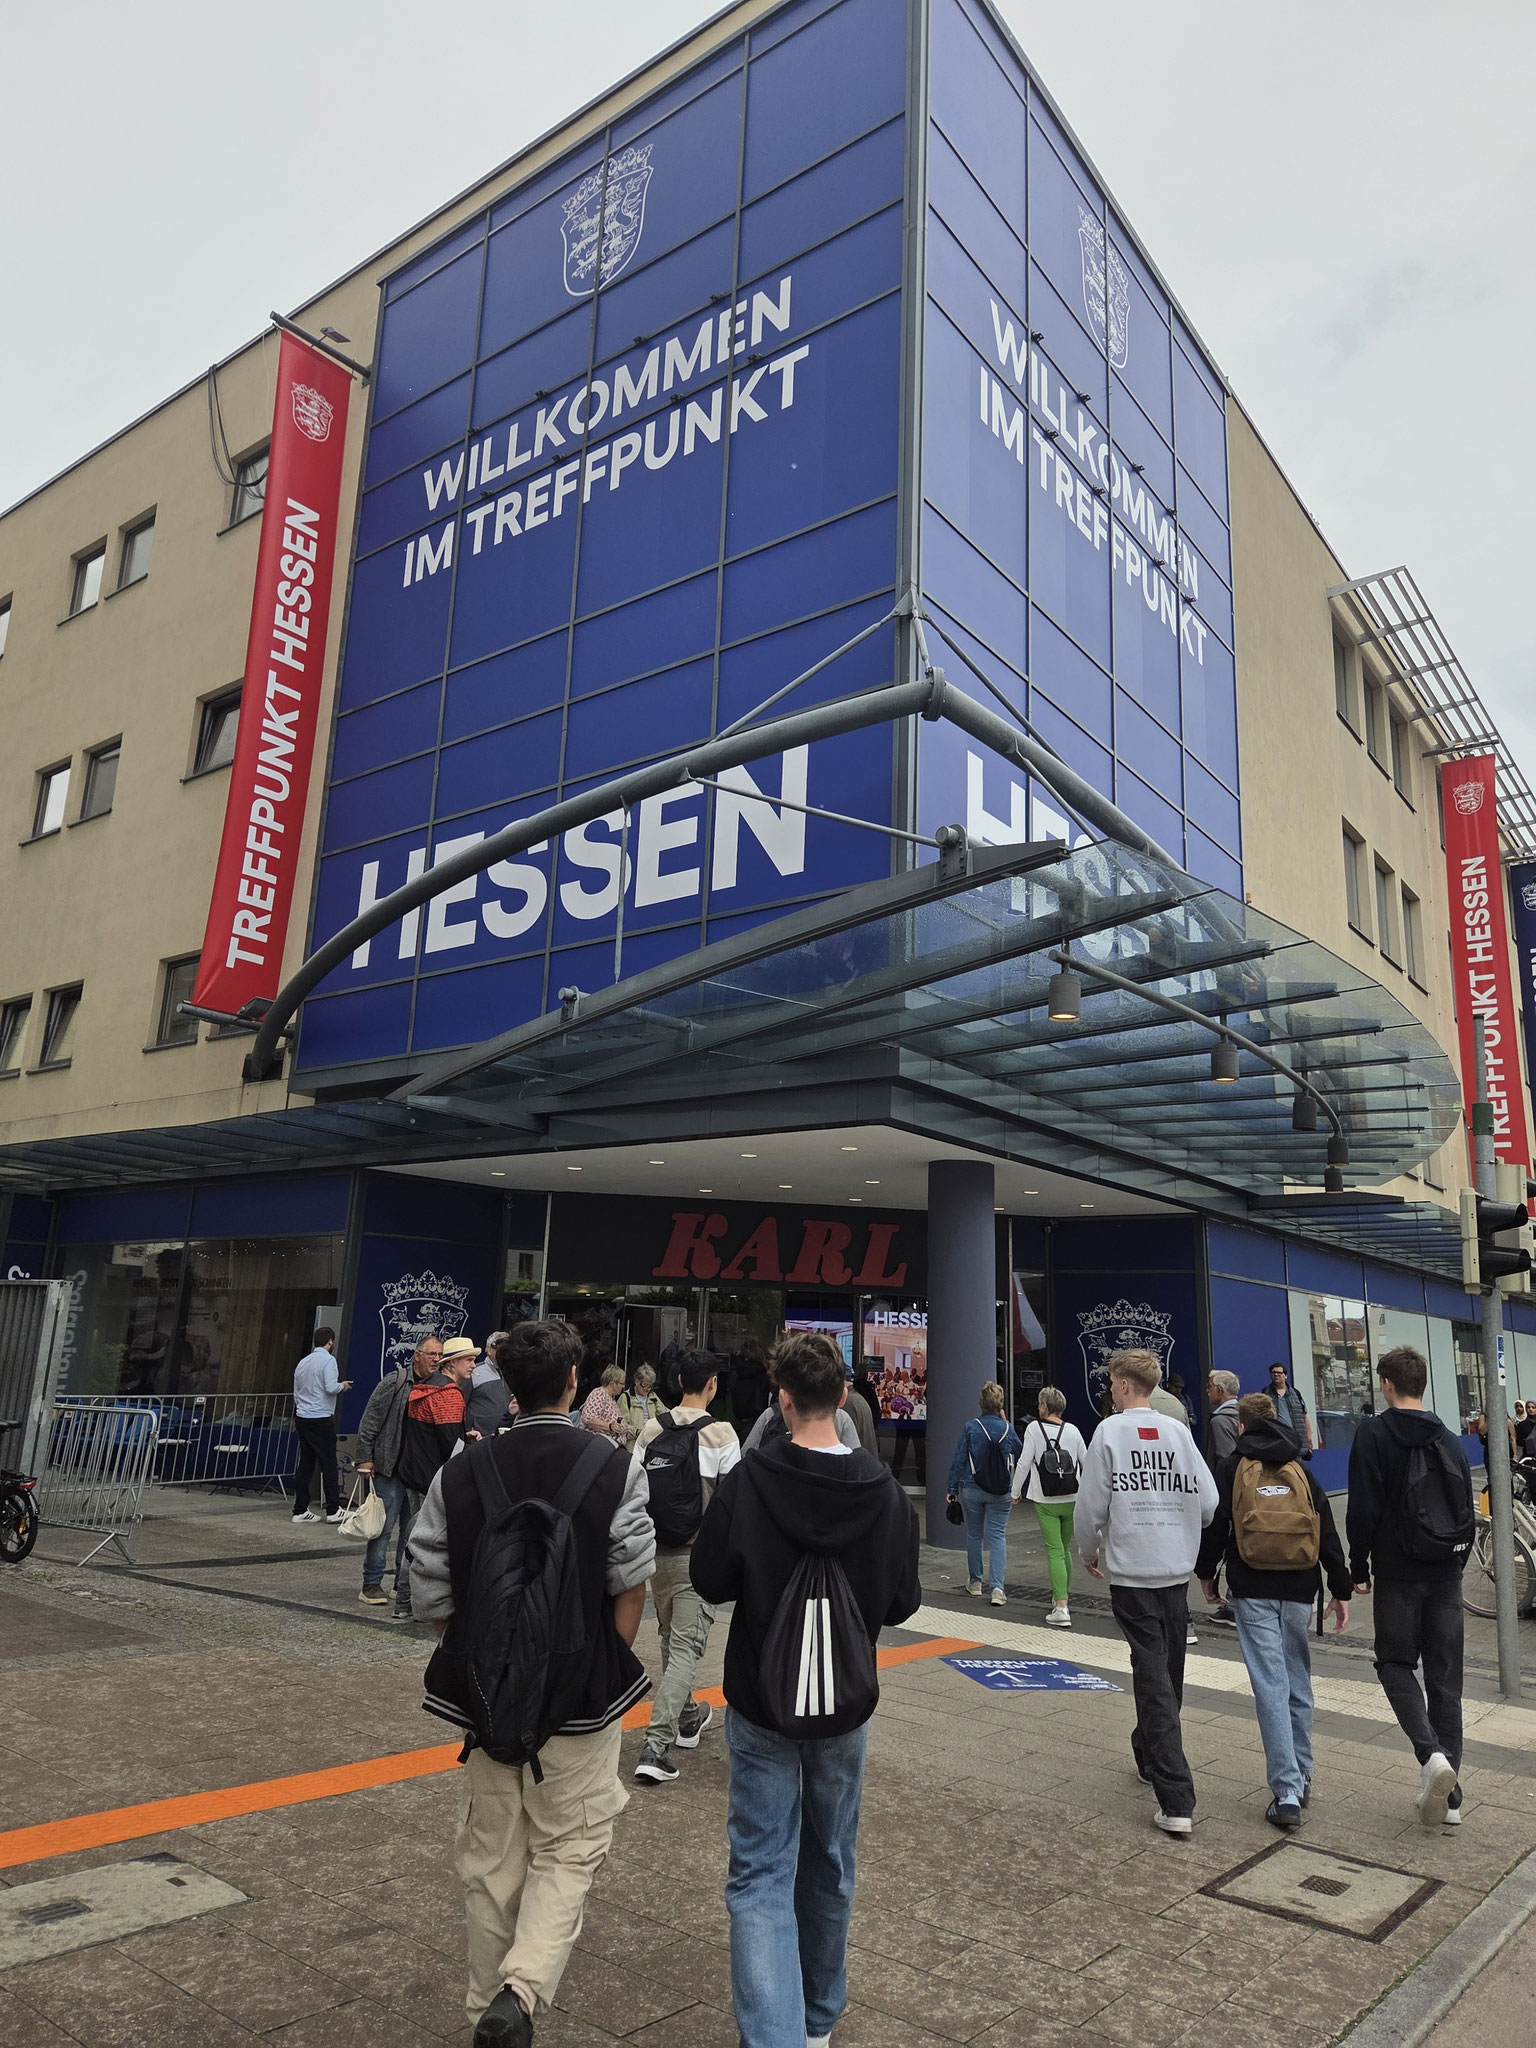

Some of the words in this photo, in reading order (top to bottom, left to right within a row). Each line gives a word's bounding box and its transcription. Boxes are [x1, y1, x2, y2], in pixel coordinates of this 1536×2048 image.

[403, 521, 455, 587] IM
[466, 344, 809, 555] TREFFPUNKT
[424, 275, 791, 511] WILLKOMMEN
[989, 298, 1198, 600] WILLKOMMEN
[980, 366, 1024, 465] IM
[1032, 426, 1207, 665] TREFFPUNKT
[225, 669, 302, 969] TREFFPUNKT
[270, 497, 320, 672] HESSEN
[352, 743, 809, 969] HESSEN
[1461, 856, 1494, 964] HESSEN
[653, 1213, 906, 1287] KARL
[874, 1311, 928, 1329] HESSE
[1130, 1450, 1175, 1470] DAILY
